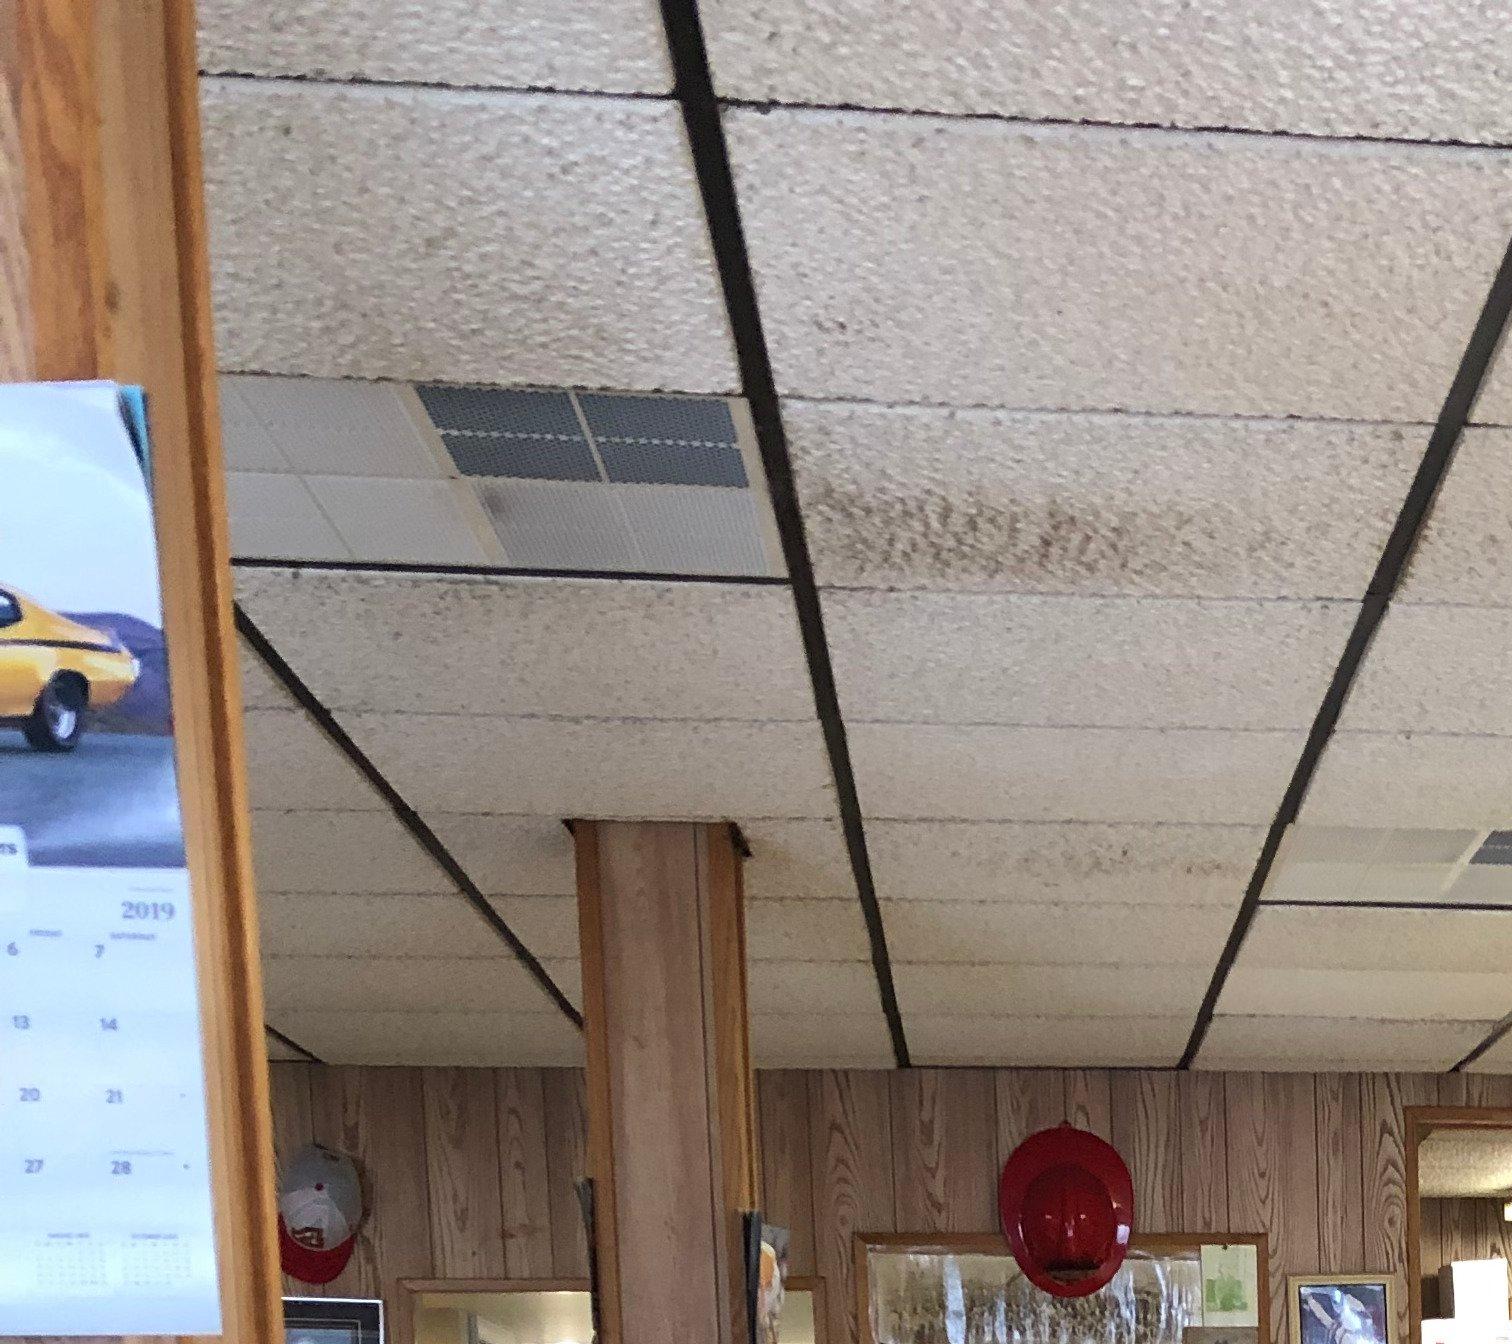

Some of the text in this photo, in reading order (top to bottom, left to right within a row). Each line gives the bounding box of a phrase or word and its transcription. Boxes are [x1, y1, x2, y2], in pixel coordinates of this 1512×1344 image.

[122, 900, 176, 920] 2019
[6, 942, 19, 956] 6
[13, 1015, 118, 1031] 13 14
[19, 1087, 123, 1104] 20 21
[24, 1159, 132, 1175] 27 28
